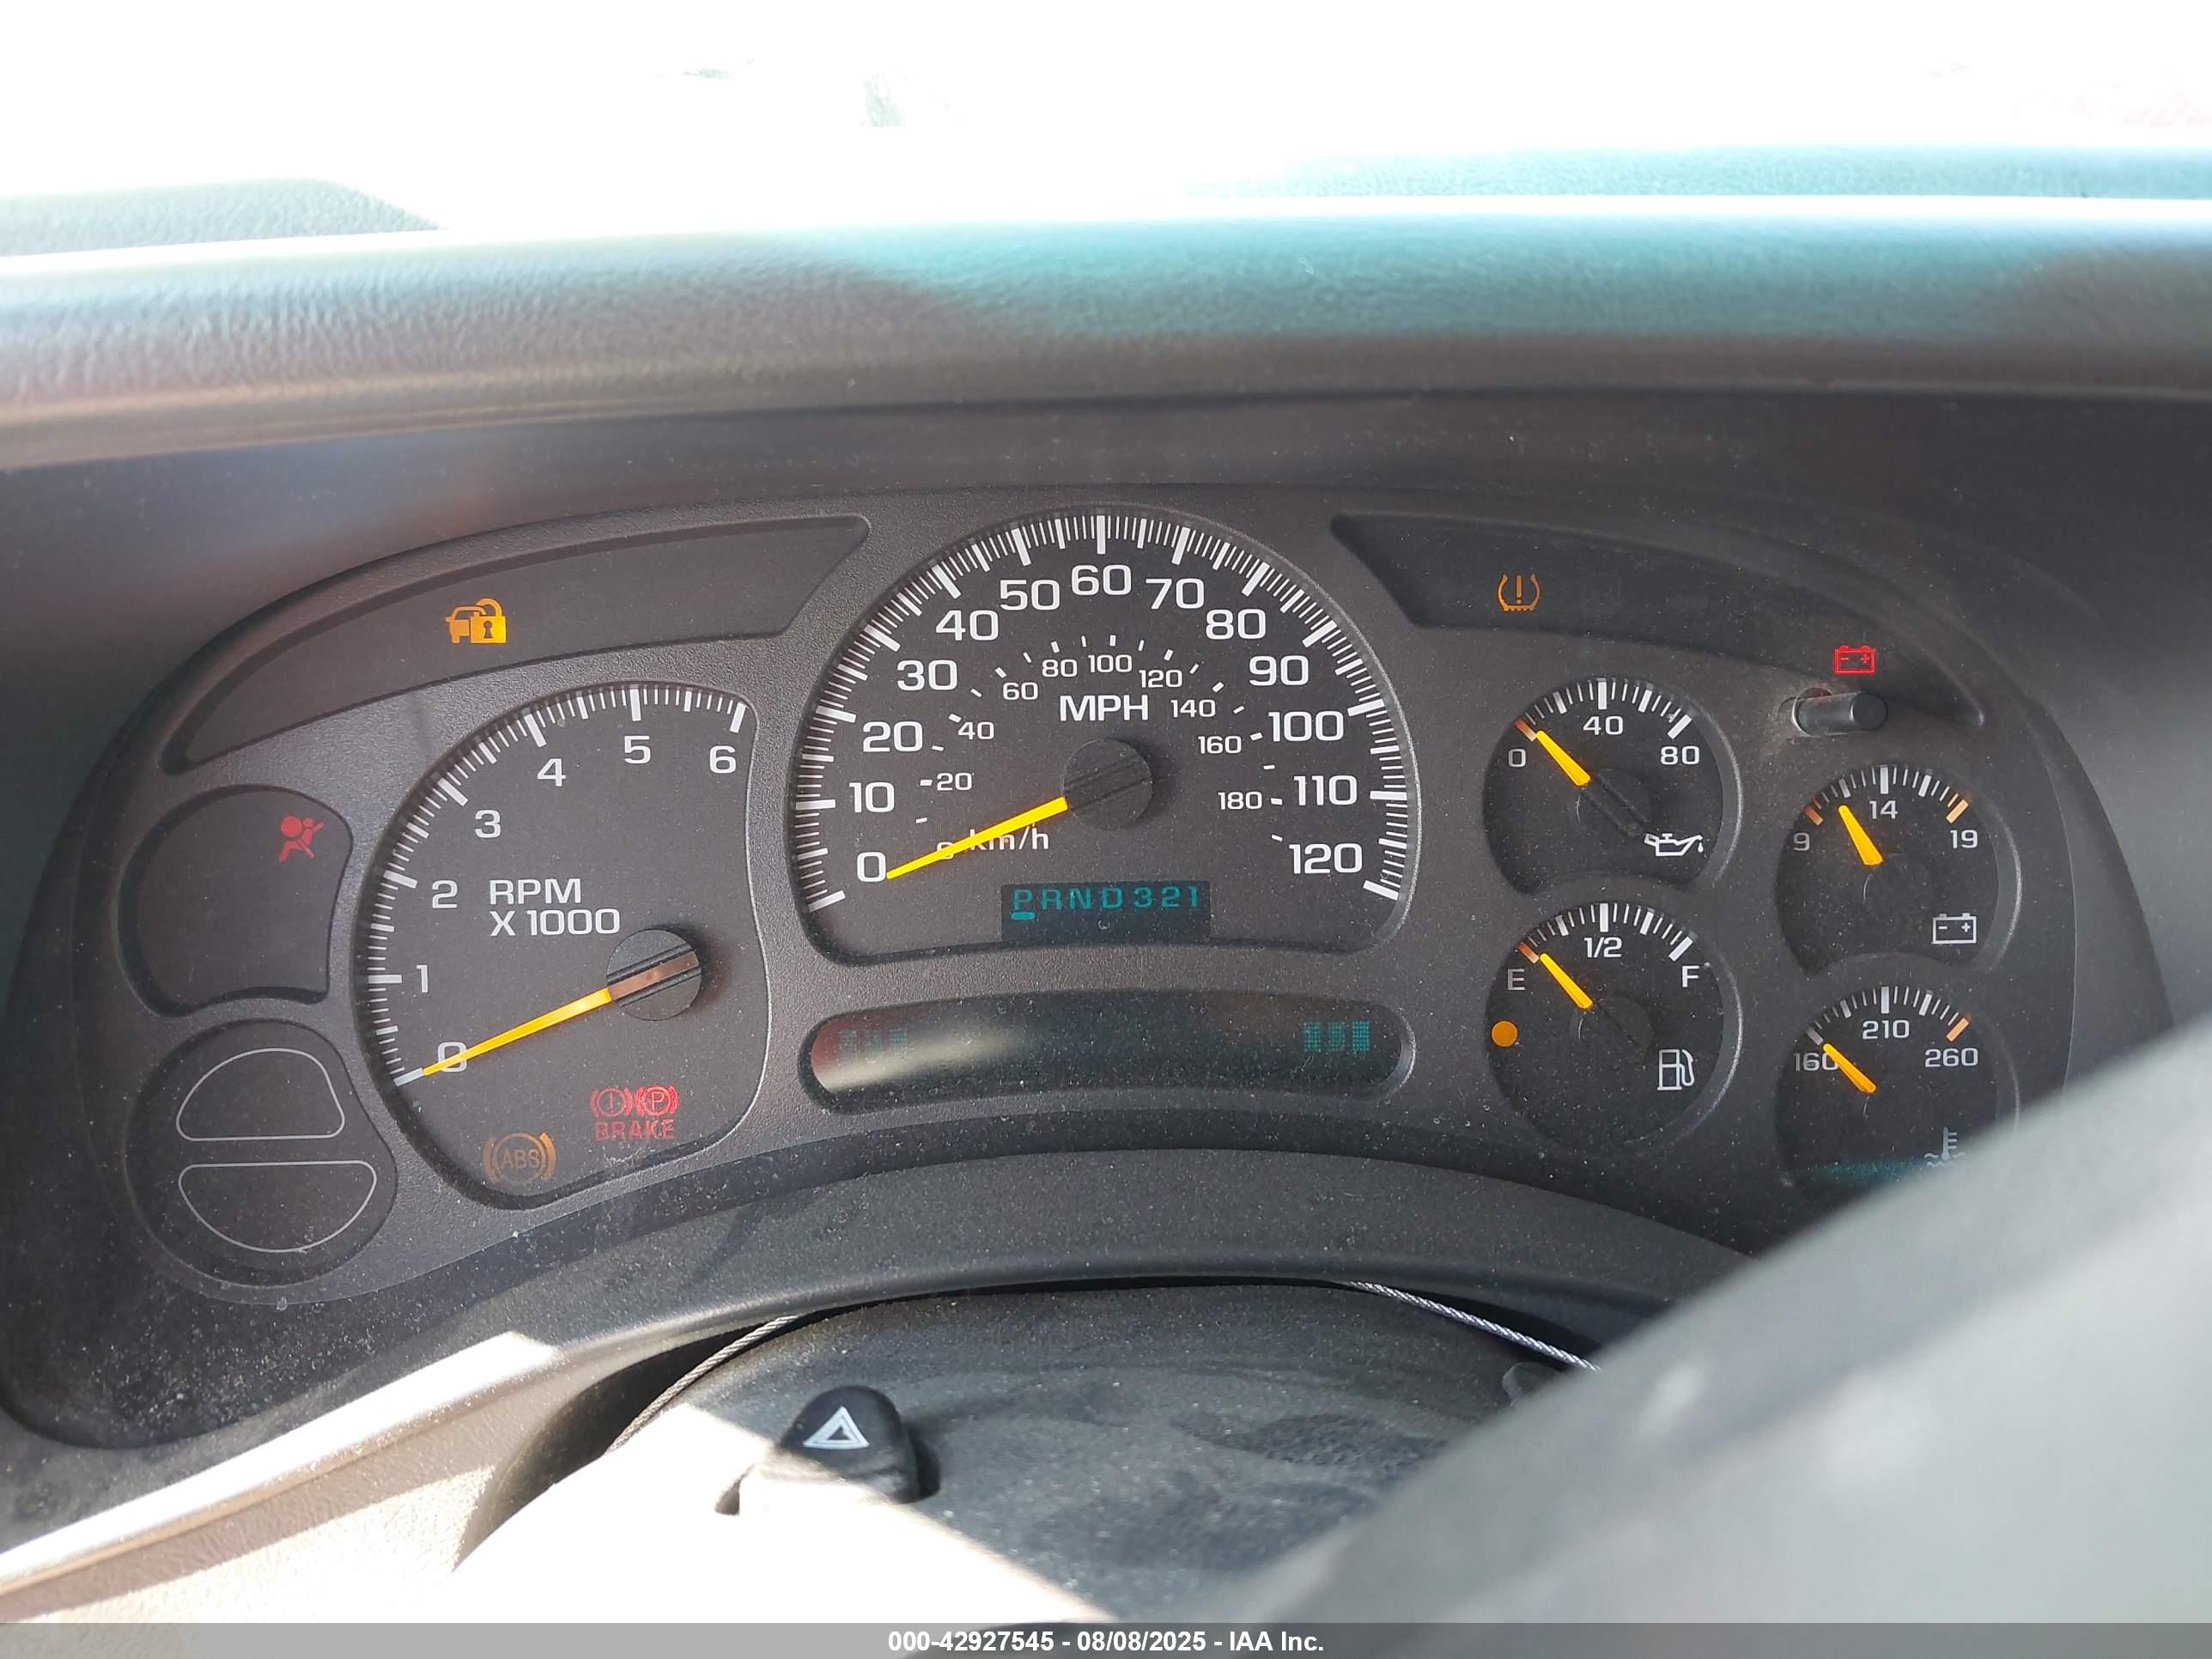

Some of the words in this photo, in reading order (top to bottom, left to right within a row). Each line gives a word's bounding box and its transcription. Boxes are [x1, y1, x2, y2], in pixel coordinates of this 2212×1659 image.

[1071, 564, 1132, 596] 60
[1000, 579, 1060, 611] 50
[1146, 578, 1205, 610] 70
[935, 610, 999, 641] 40
[1206, 609, 1267, 640] 80
[896, 659, 957, 691] 30
[1042, 659, 1078, 678] 80
[1087, 654, 1133, 673] 100
[1249, 655, 1309, 686] 90
[1139, 669, 1182, 688] 120
[1002, 682, 1038, 701] 60
[1060, 694, 1149, 721] MPH
[1170, 699, 1216, 718] 140
[863, 720, 923, 752] 20
[957, 721, 994, 740] 40
[1268, 710, 1344, 742] 100
[1583, 715, 1624, 736] 40
[624, 735, 651, 764] 5
[1198, 735, 1242, 754] 160
[1660, 745, 1700, 765] 80
[709, 745, 737, 774] 6
[1508, 748, 1527, 768] 0
[537, 758, 567, 787] 4
[937, 772, 972, 791] 20
[848, 781, 895, 813] 10
[1218, 791, 1262, 811] 180
[1293, 775, 1358, 806] 110
[1869, 800, 1899, 819] 14
[475, 809, 501, 838] 3
[1794, 832, 1810, 851] 9
[1949, 830, 1978, 849] 19
[856, 851, 886, 883] 0
[1288, 842, 1363, 874] 120
[432, 879, 458, 908] 2
[489, 878, 581, 905] RPM
[526, 908, 620, 936] 1000
[1583, 937, 1622, 958] 1/2
[416, 964, 428, 994] 1
[1507, 968, 1526, 991] E
[1681, 965, 1699, 988] F
[1862, 1019, 1910, 1040] 210
[437, 1042, 468, 1073] 0
[1795, 1052, 1839, 1072] 160
[1924, 1048, 1978, 1067] 260
[593, 1119, 674, 1141] BRAKE
[502, 1149, 542, 1169] ABS
